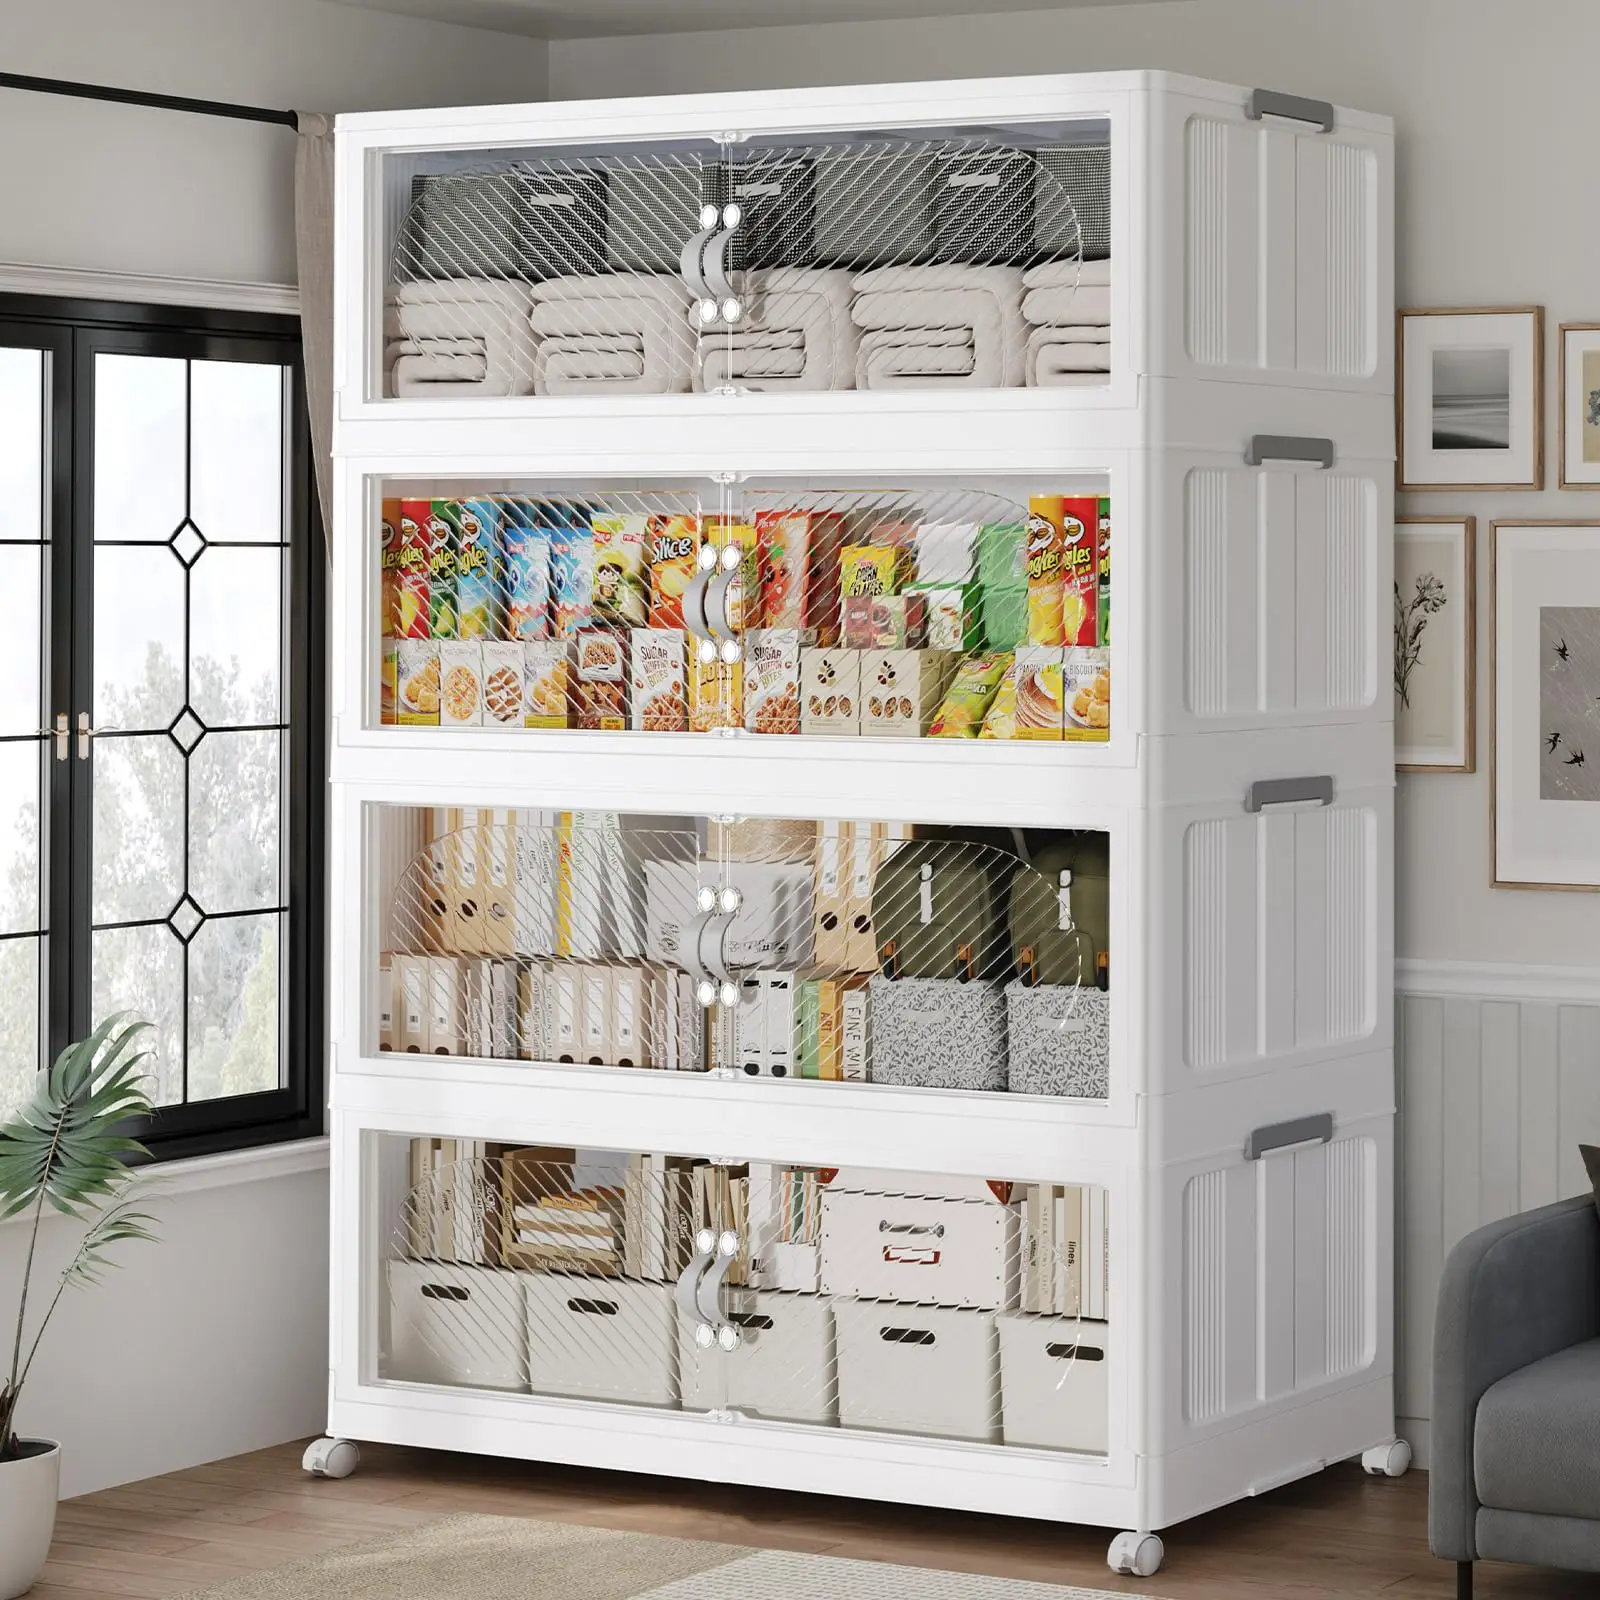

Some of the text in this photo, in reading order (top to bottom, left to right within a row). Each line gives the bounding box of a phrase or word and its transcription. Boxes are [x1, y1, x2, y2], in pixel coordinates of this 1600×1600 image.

[651, 536, 692, 565] Slice
[641, 646, 668, 660] SUGAR
[753, 645, 782, 661] SUGAR
[846, 1006, 862, 1041] FINE
[1067, 1240, 1077, 1268] lines.
